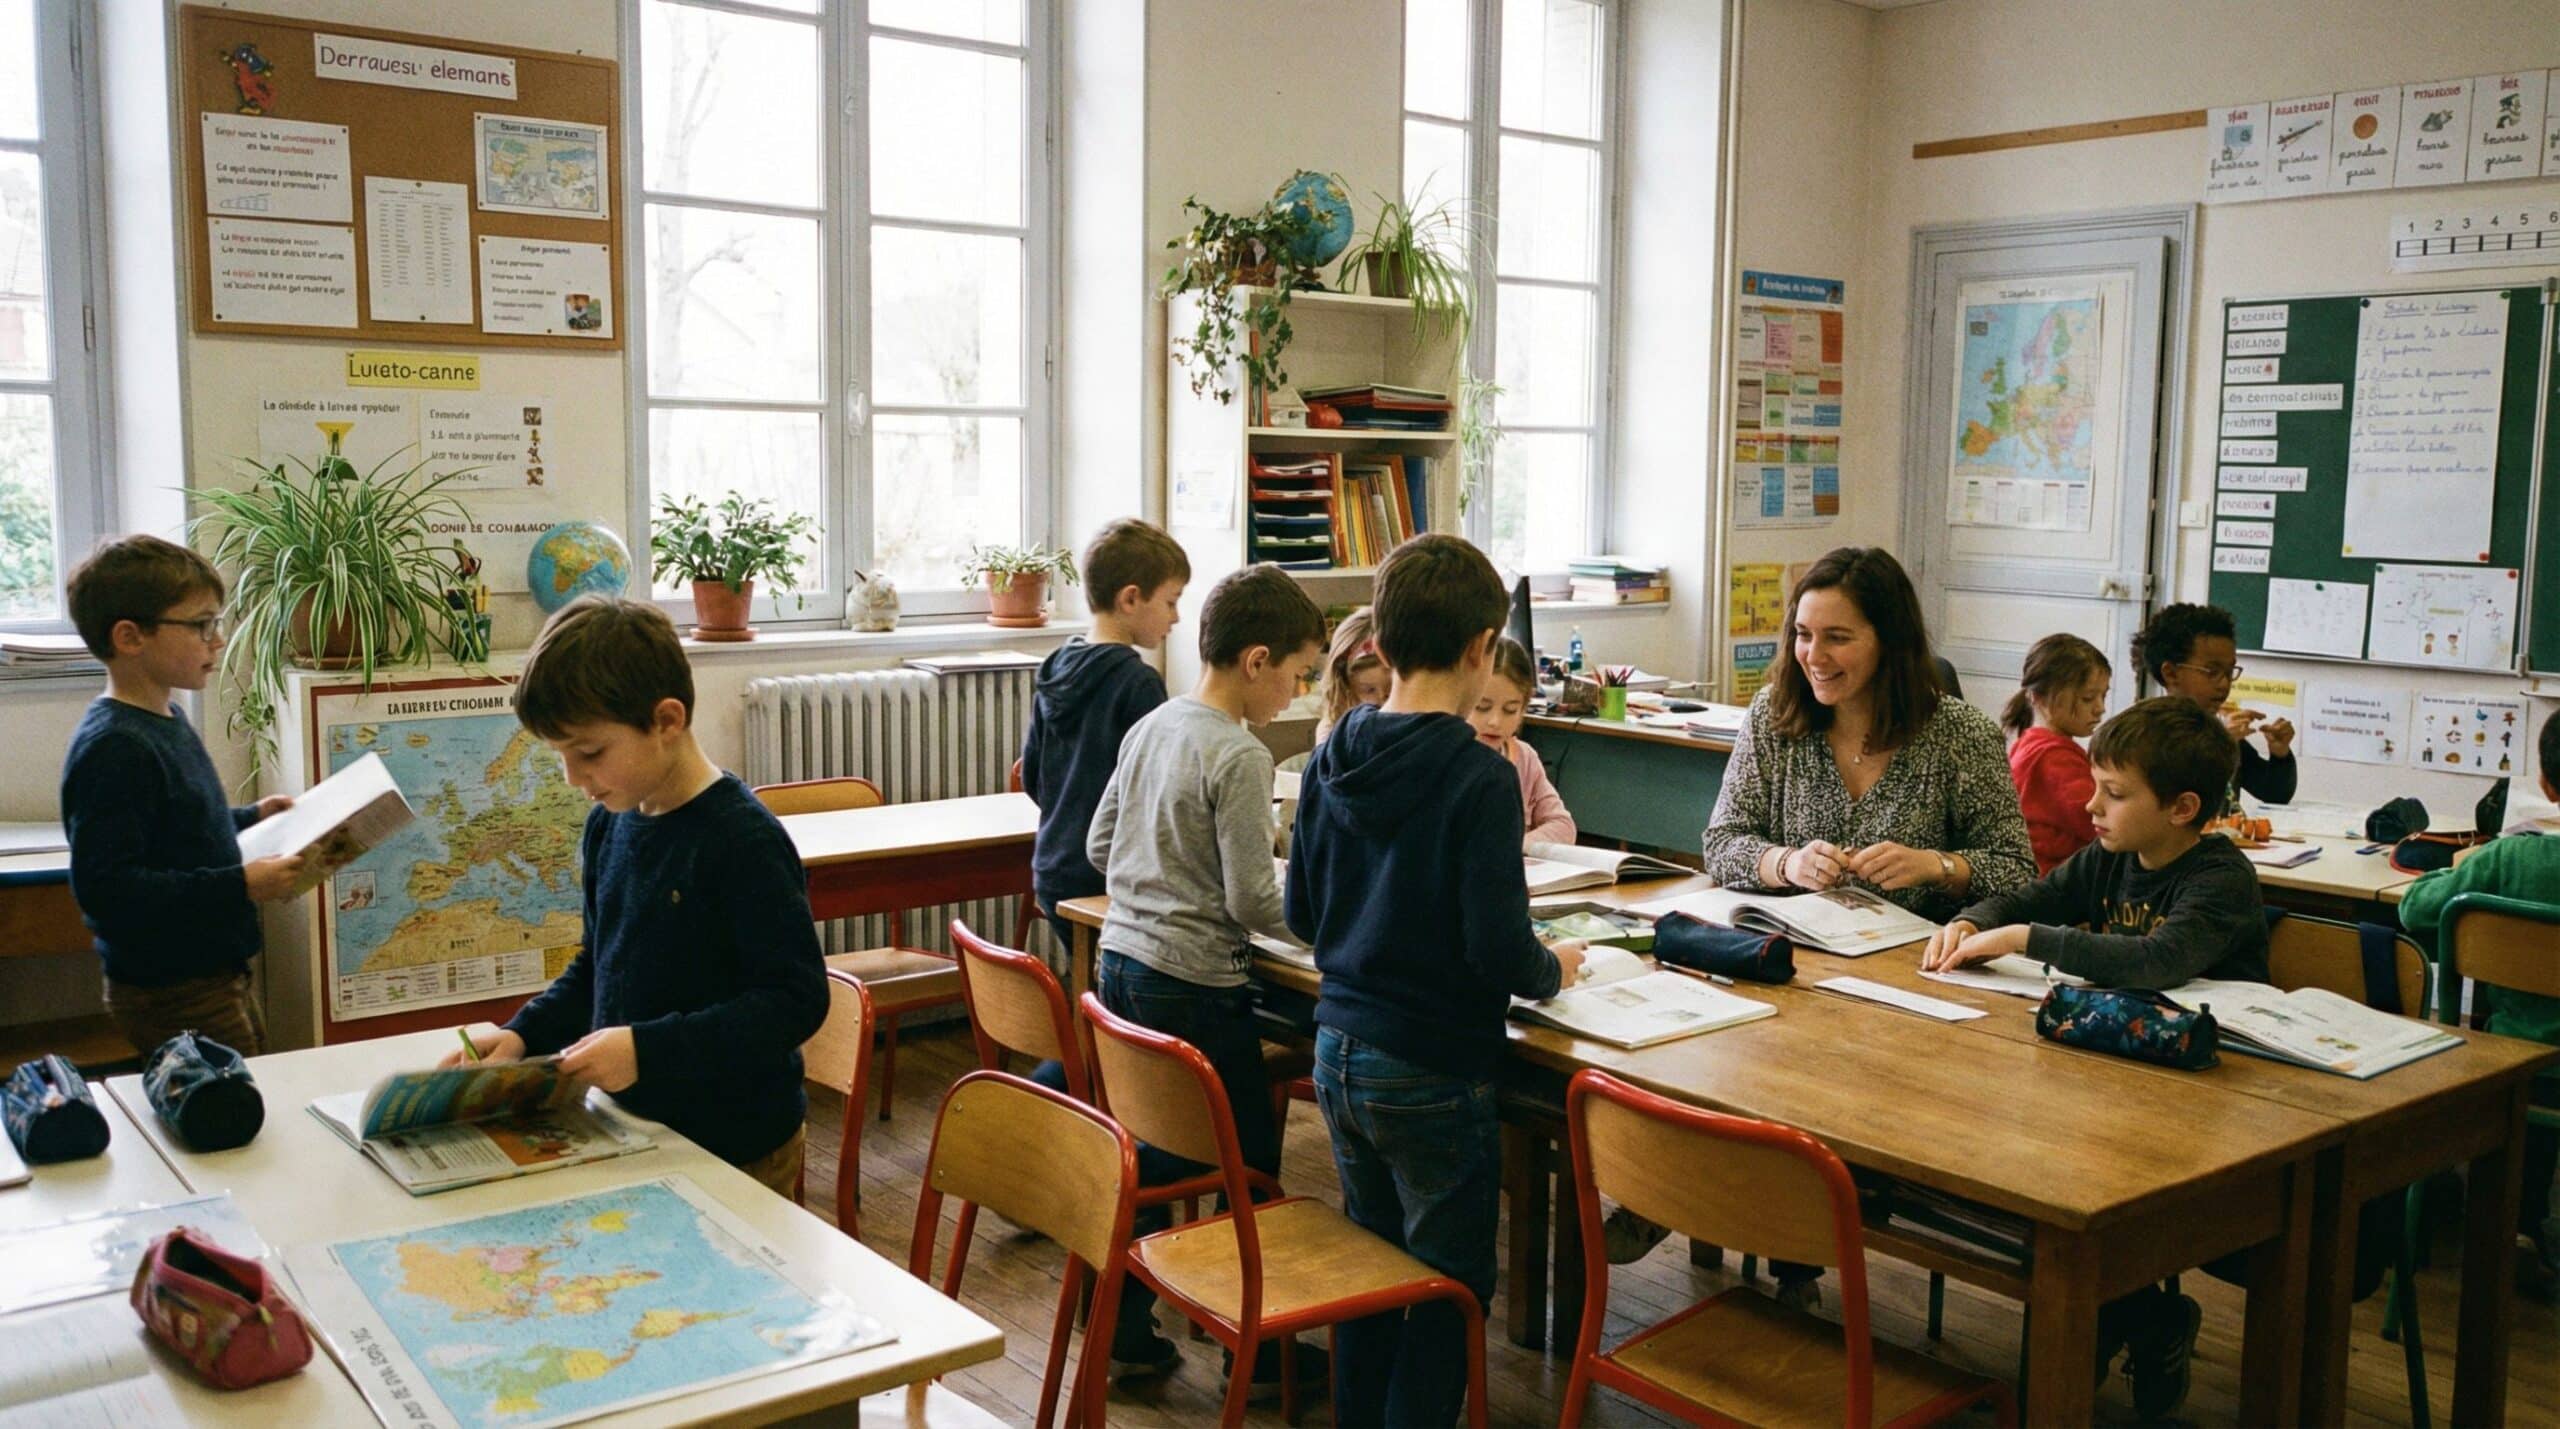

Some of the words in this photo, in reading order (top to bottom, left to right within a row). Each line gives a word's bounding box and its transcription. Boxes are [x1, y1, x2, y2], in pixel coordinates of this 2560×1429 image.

[2408, 222, 2415, 233] 1
[2434, 220, 2443, 231] 2
[2462, 218, 2471, 229] 3
[2490, 215, 2499, 226] 4
[2520, 213, 2528, 225] 5
[2549, 211, 2558, 223] 6
